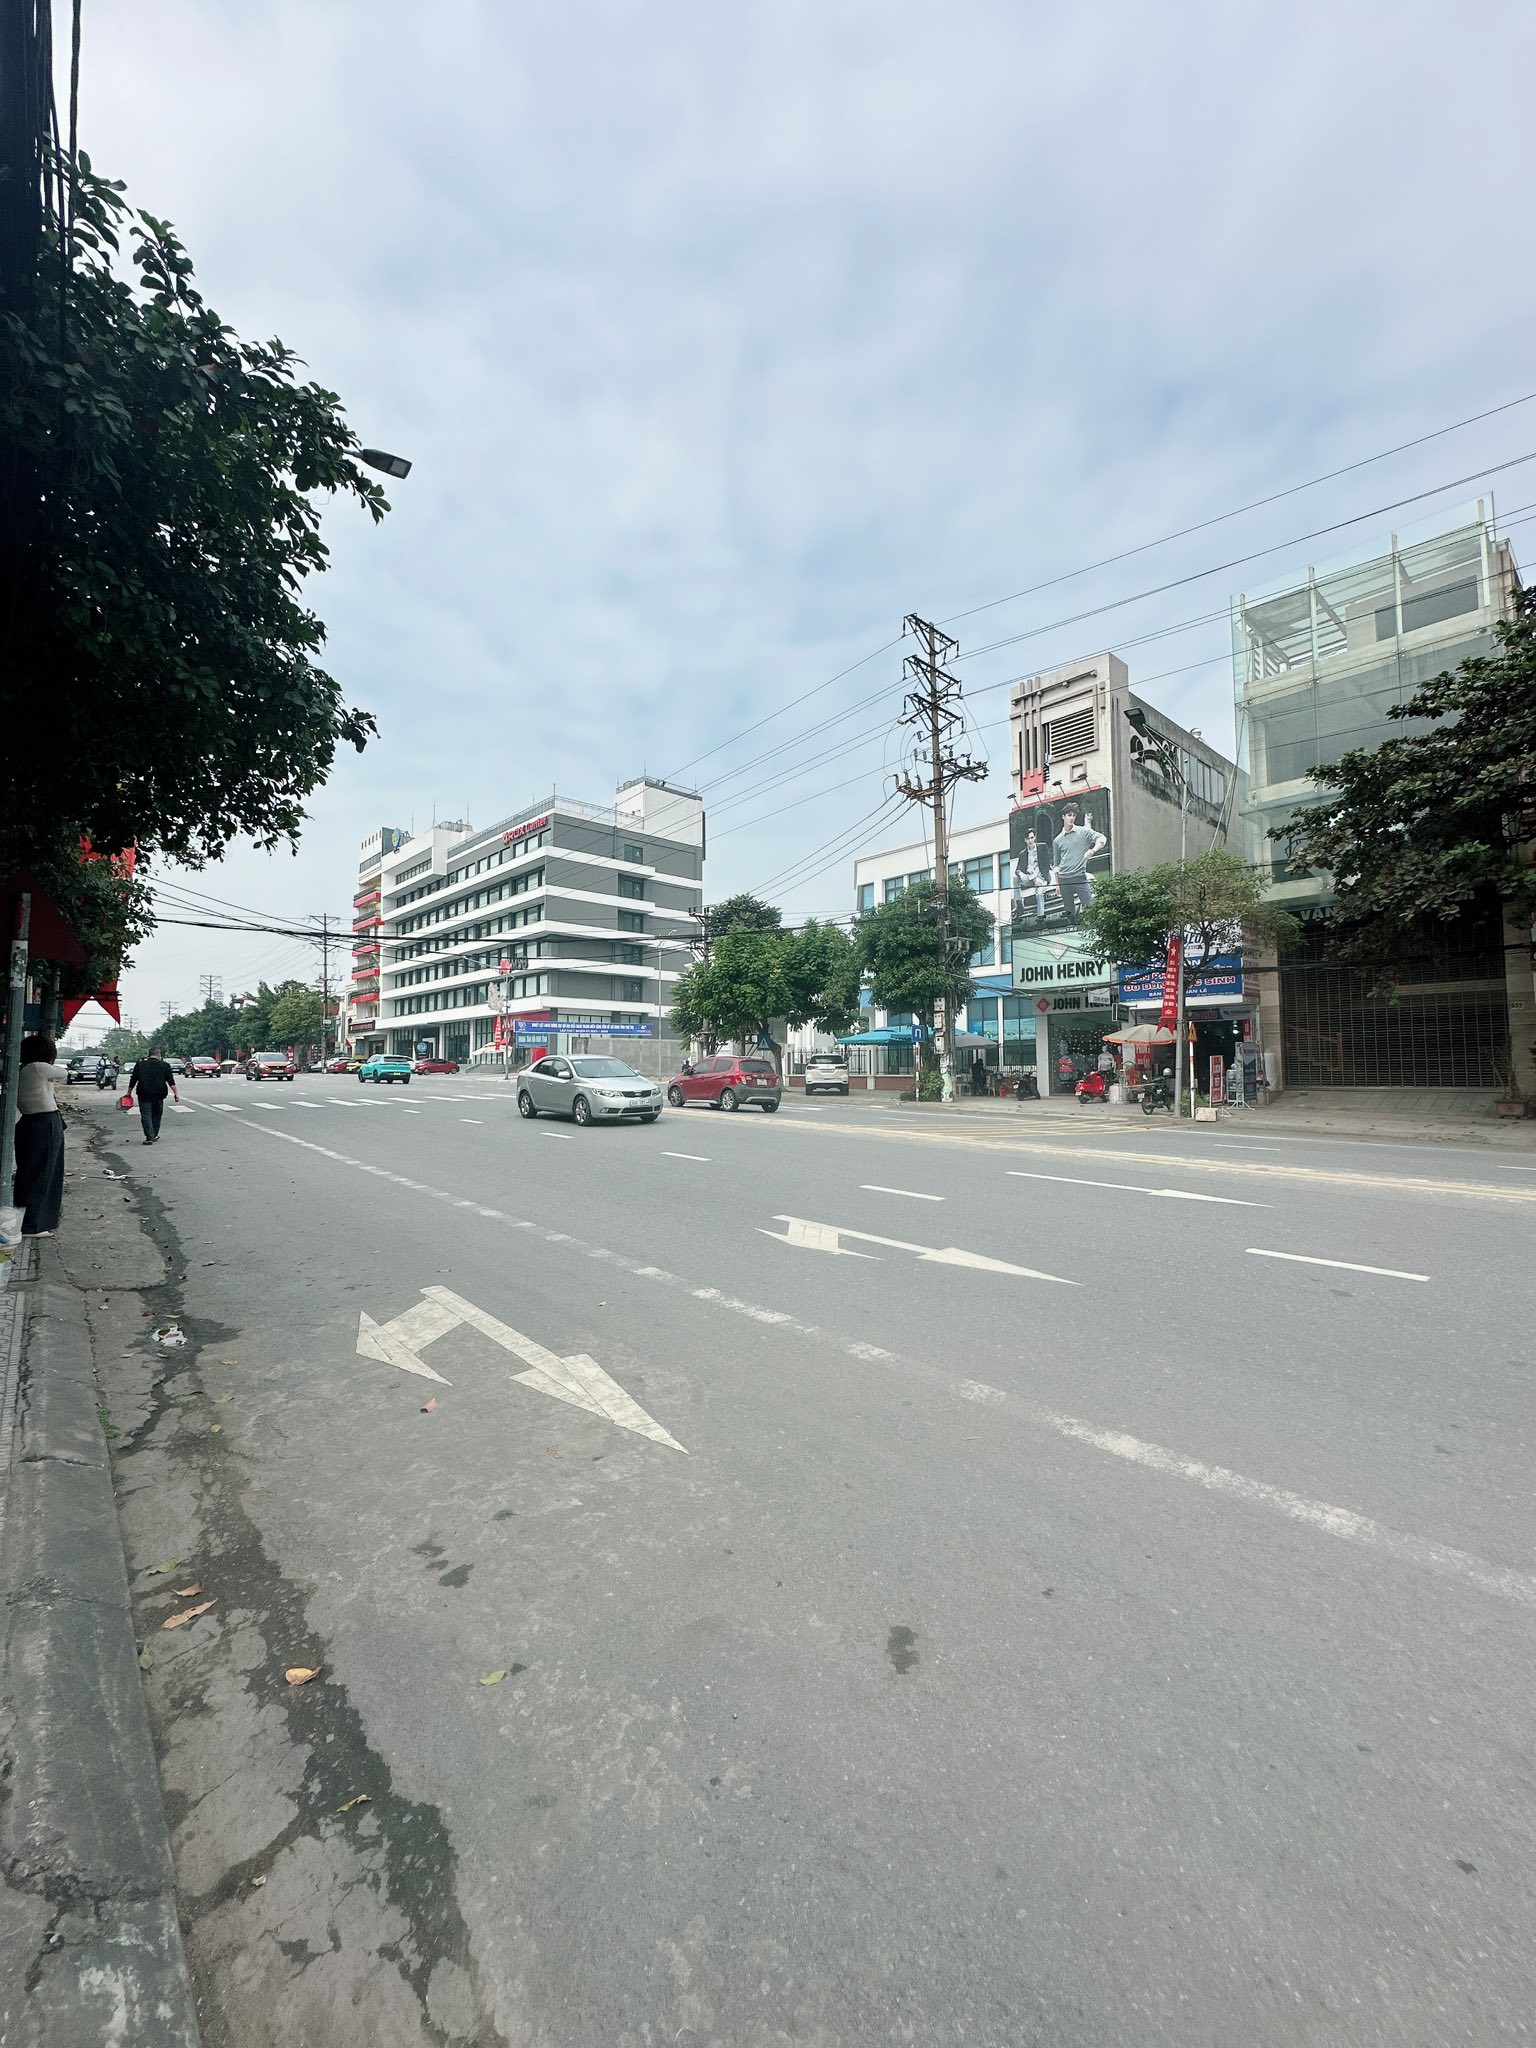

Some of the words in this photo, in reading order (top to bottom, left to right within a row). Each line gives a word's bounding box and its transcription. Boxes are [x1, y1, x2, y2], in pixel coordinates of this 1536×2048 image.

[527, 816, 548, 832] Center
[1020, 965, 1053, 983] JOHN
[1057, 959, 1105, 980] HENRY
[1204, 976, 1235, 986] SINH
[1052, 997, 1080, 1010] JOHN
